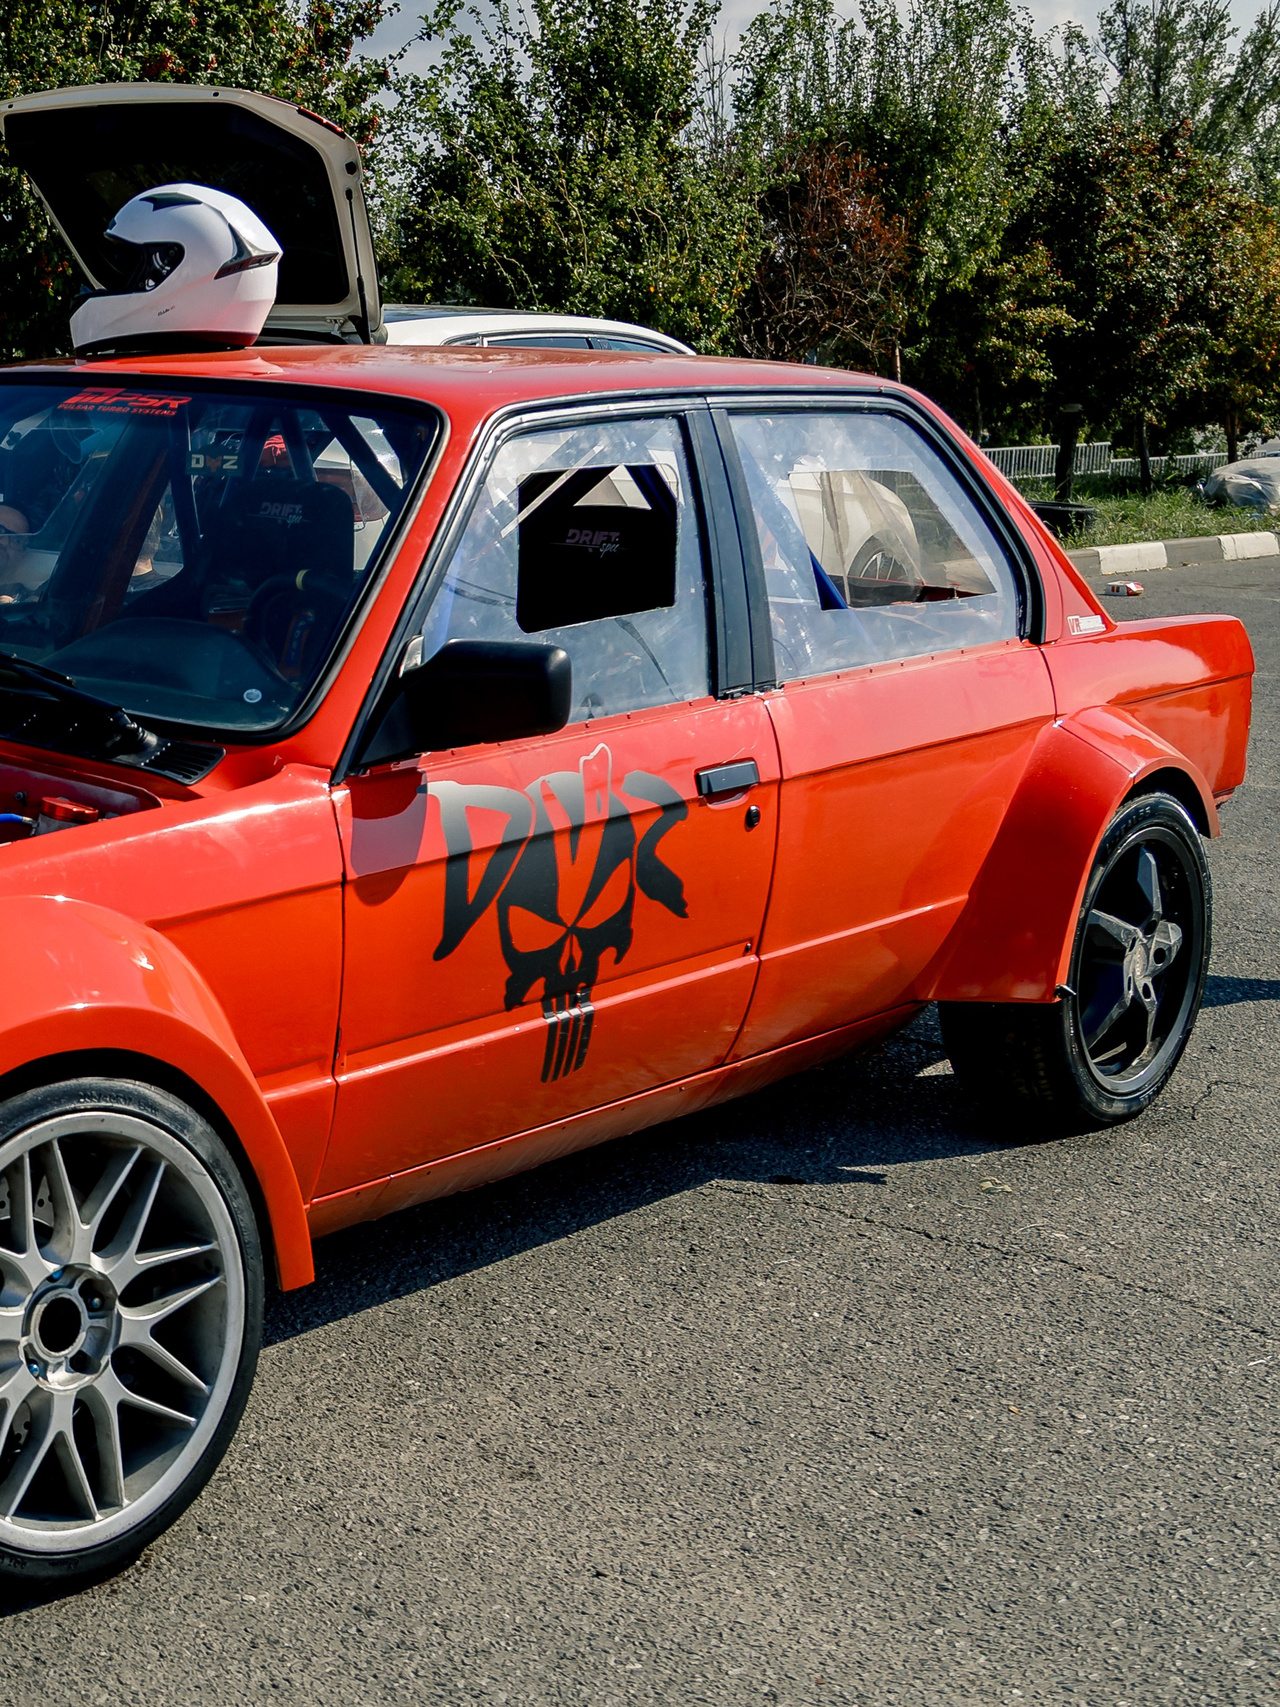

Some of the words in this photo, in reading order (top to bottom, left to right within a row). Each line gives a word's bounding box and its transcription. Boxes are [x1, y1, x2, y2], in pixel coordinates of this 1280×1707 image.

[57, 403, 95, 412] PULSAR
[97, 405, 130, 414] TURBO
[131, 407, 177, 416] SYSTEMS
